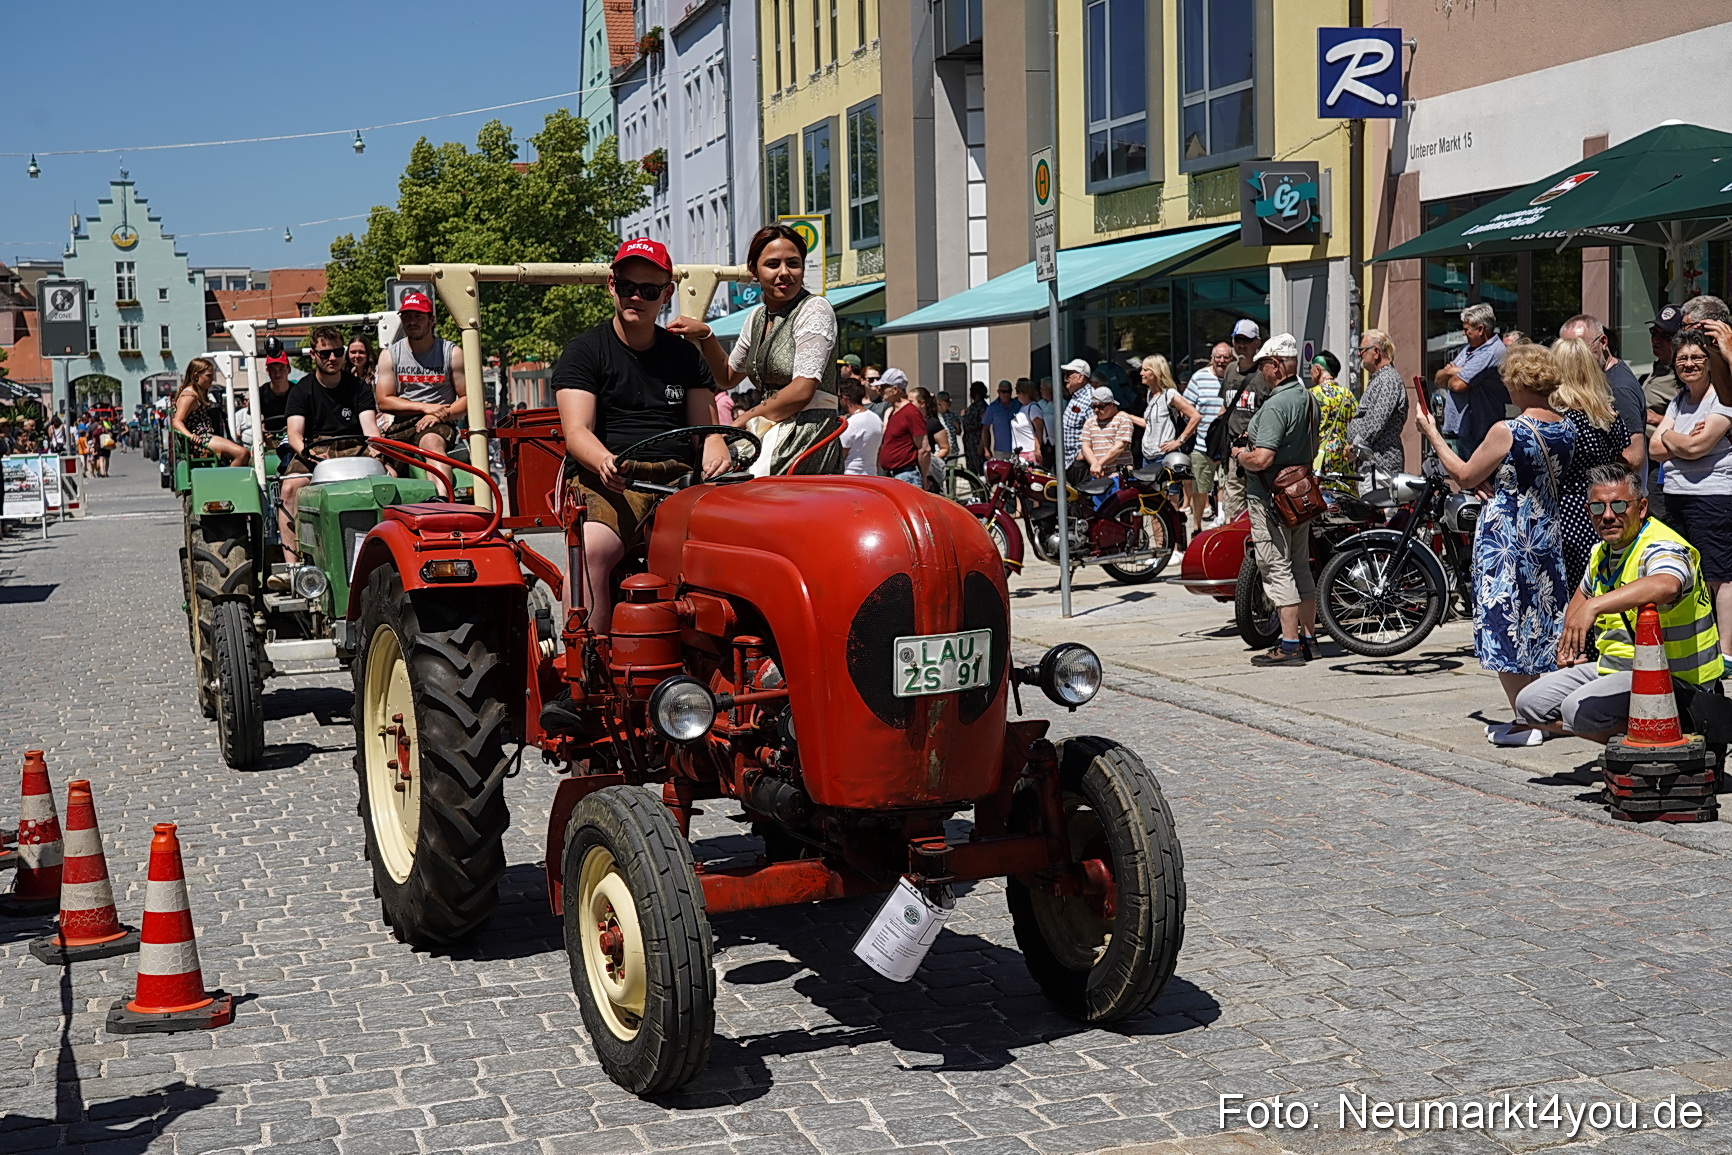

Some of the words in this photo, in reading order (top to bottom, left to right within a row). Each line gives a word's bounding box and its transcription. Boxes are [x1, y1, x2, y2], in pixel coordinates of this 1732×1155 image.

[1410, 142, 1437, 160] Unterer
[1439, 135, 1461, 154] Markt
[1463, 131, 1473, 149] 15
[1273, 183, 1300, 218] G2
[1035, 221, 1054, 240] Schulbus
[626, 242, 654, 254] DEKRA
[742, 287, 757, 304] G2
[54, 312, 73, 320] ZONE
[397, 366, 445, 375] JACK&JONES
[921, 636, 975, 665] LAU
[904, 666, 941, 691] ZS
[958, 661, 980, 686] 91
